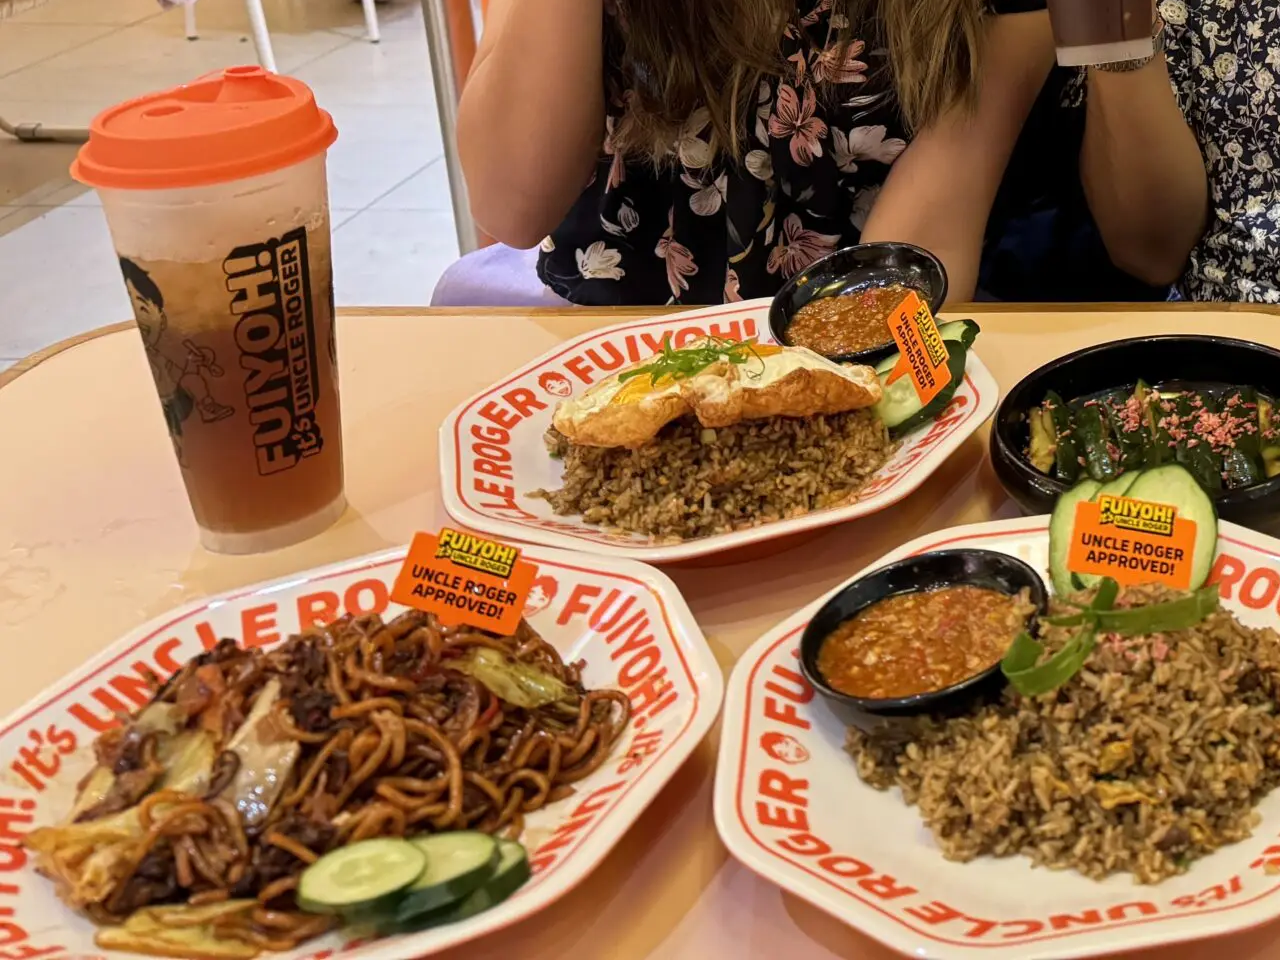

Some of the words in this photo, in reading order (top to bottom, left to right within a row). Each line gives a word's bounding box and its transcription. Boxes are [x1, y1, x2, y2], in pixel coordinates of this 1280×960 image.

[280, 244, 304, 332] ROGER
[222, 248, 297, 477] FUIYOH!
[896, 325, 928, 390] APPROVED!
[900, 311, 919, 349] UNCLE
[915, 348, 935, 388] ROGER
[918, 305, 946, 362] FUIYOH!
[289, 334, 312, 413] UNCLE
[470, 387, 549, 481] ROGER
[1100, 497, 1175, 524] FUIYOH!
[440, 529, 517, 565] FUIYOH!
[1081, 532, 1130, 552] UNCLE
[1132, 541, 1184, 561] ROGER
[1085, 550, 1175, 576] APPROVED!
[411, 564, 462, 590] UNCLE
[463, 580, 518, 606] ROGER
[411, 583, 504, 620] APPROVED!
[556, 583, 679, 730] FUIYOH!
[10, 724, 78, 792] It's
[755, 769, 919, 901] ROGER
[903, 900, 1158, 938] UNCLE
